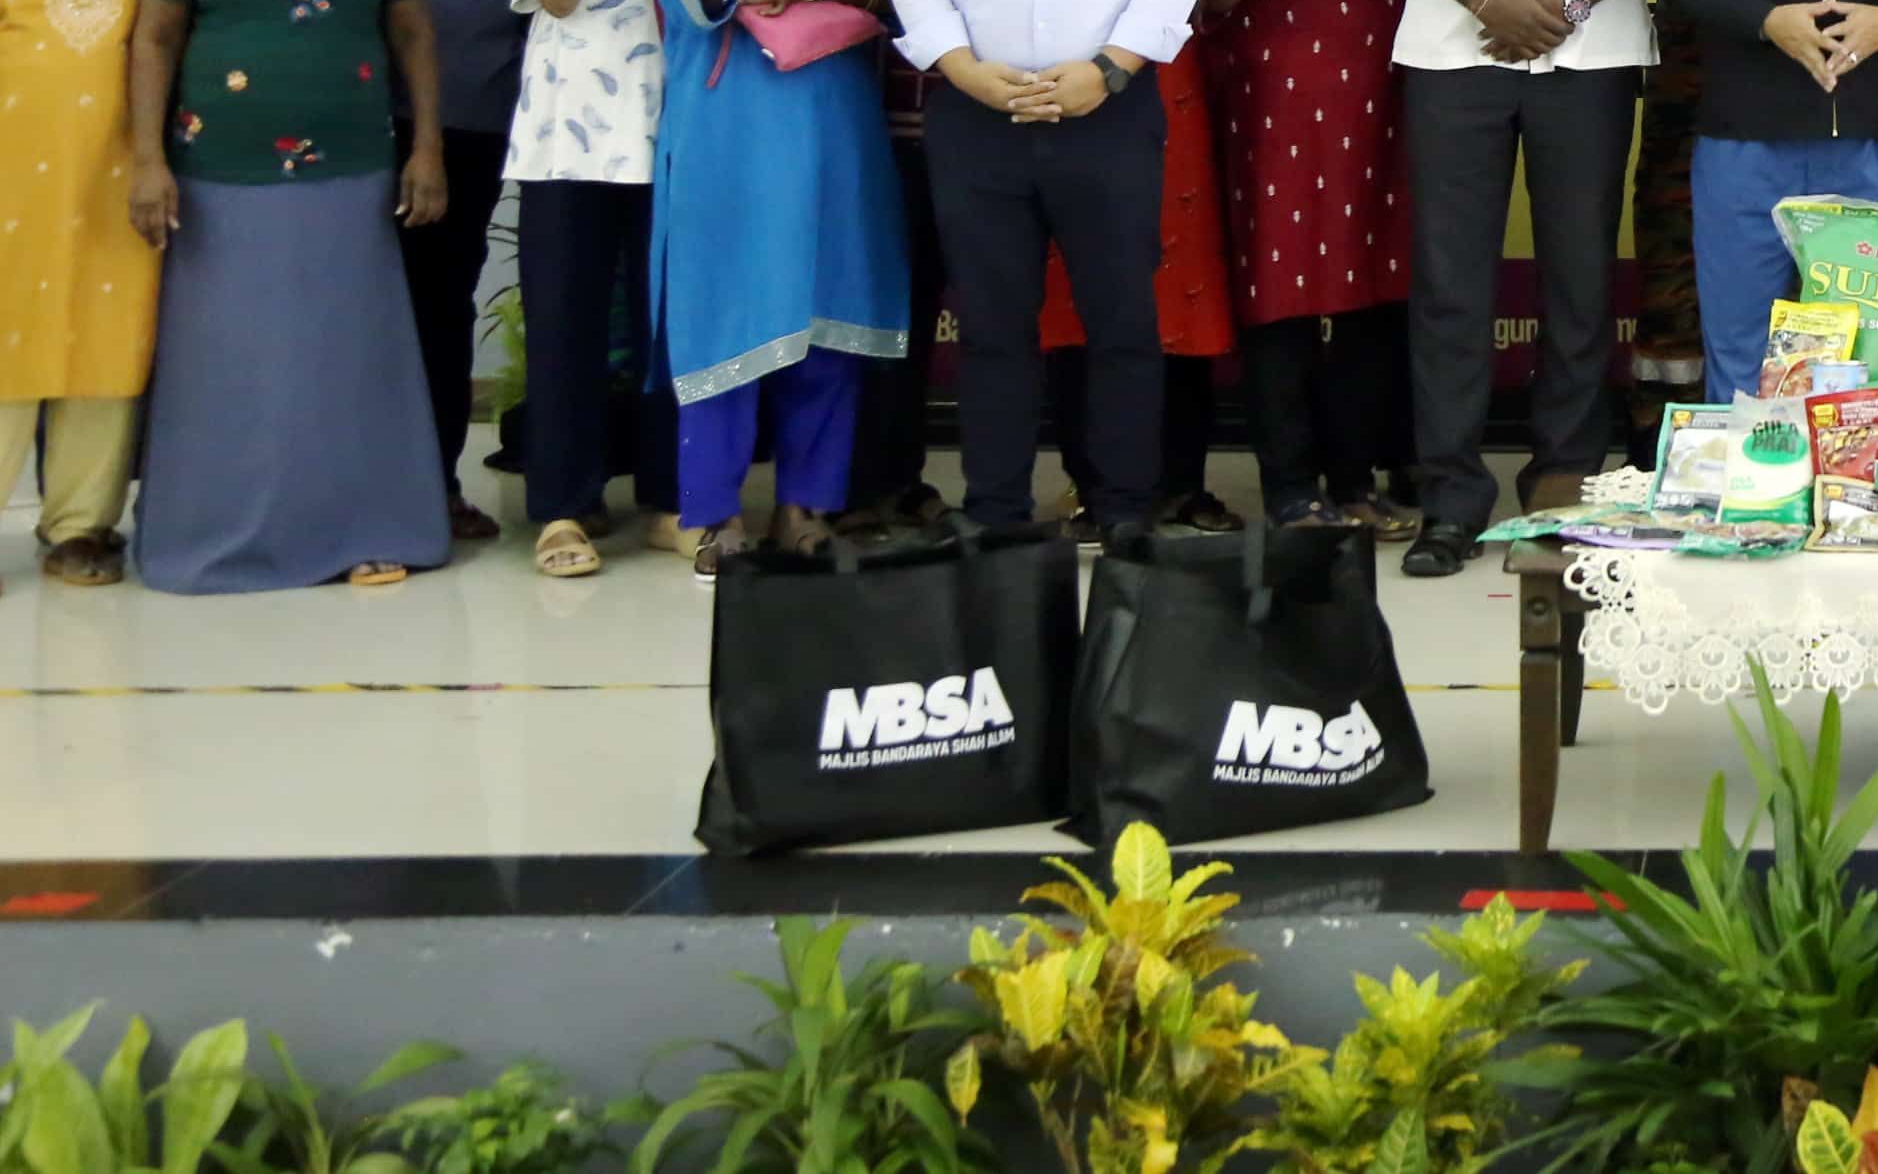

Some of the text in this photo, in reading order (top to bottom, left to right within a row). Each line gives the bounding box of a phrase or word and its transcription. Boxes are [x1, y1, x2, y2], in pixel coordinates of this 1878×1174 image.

[819, 665, 1014, 751] MBSA
[819, 751, 869, 770] MAJLIS
[871, 742, 950, 765] BANDARAYA
[952, 733, 986, 754] SHAH
[1213, 764, 1260, 784] MAJLIS
[1261, 768, 1337, 787] BANDARAYA
